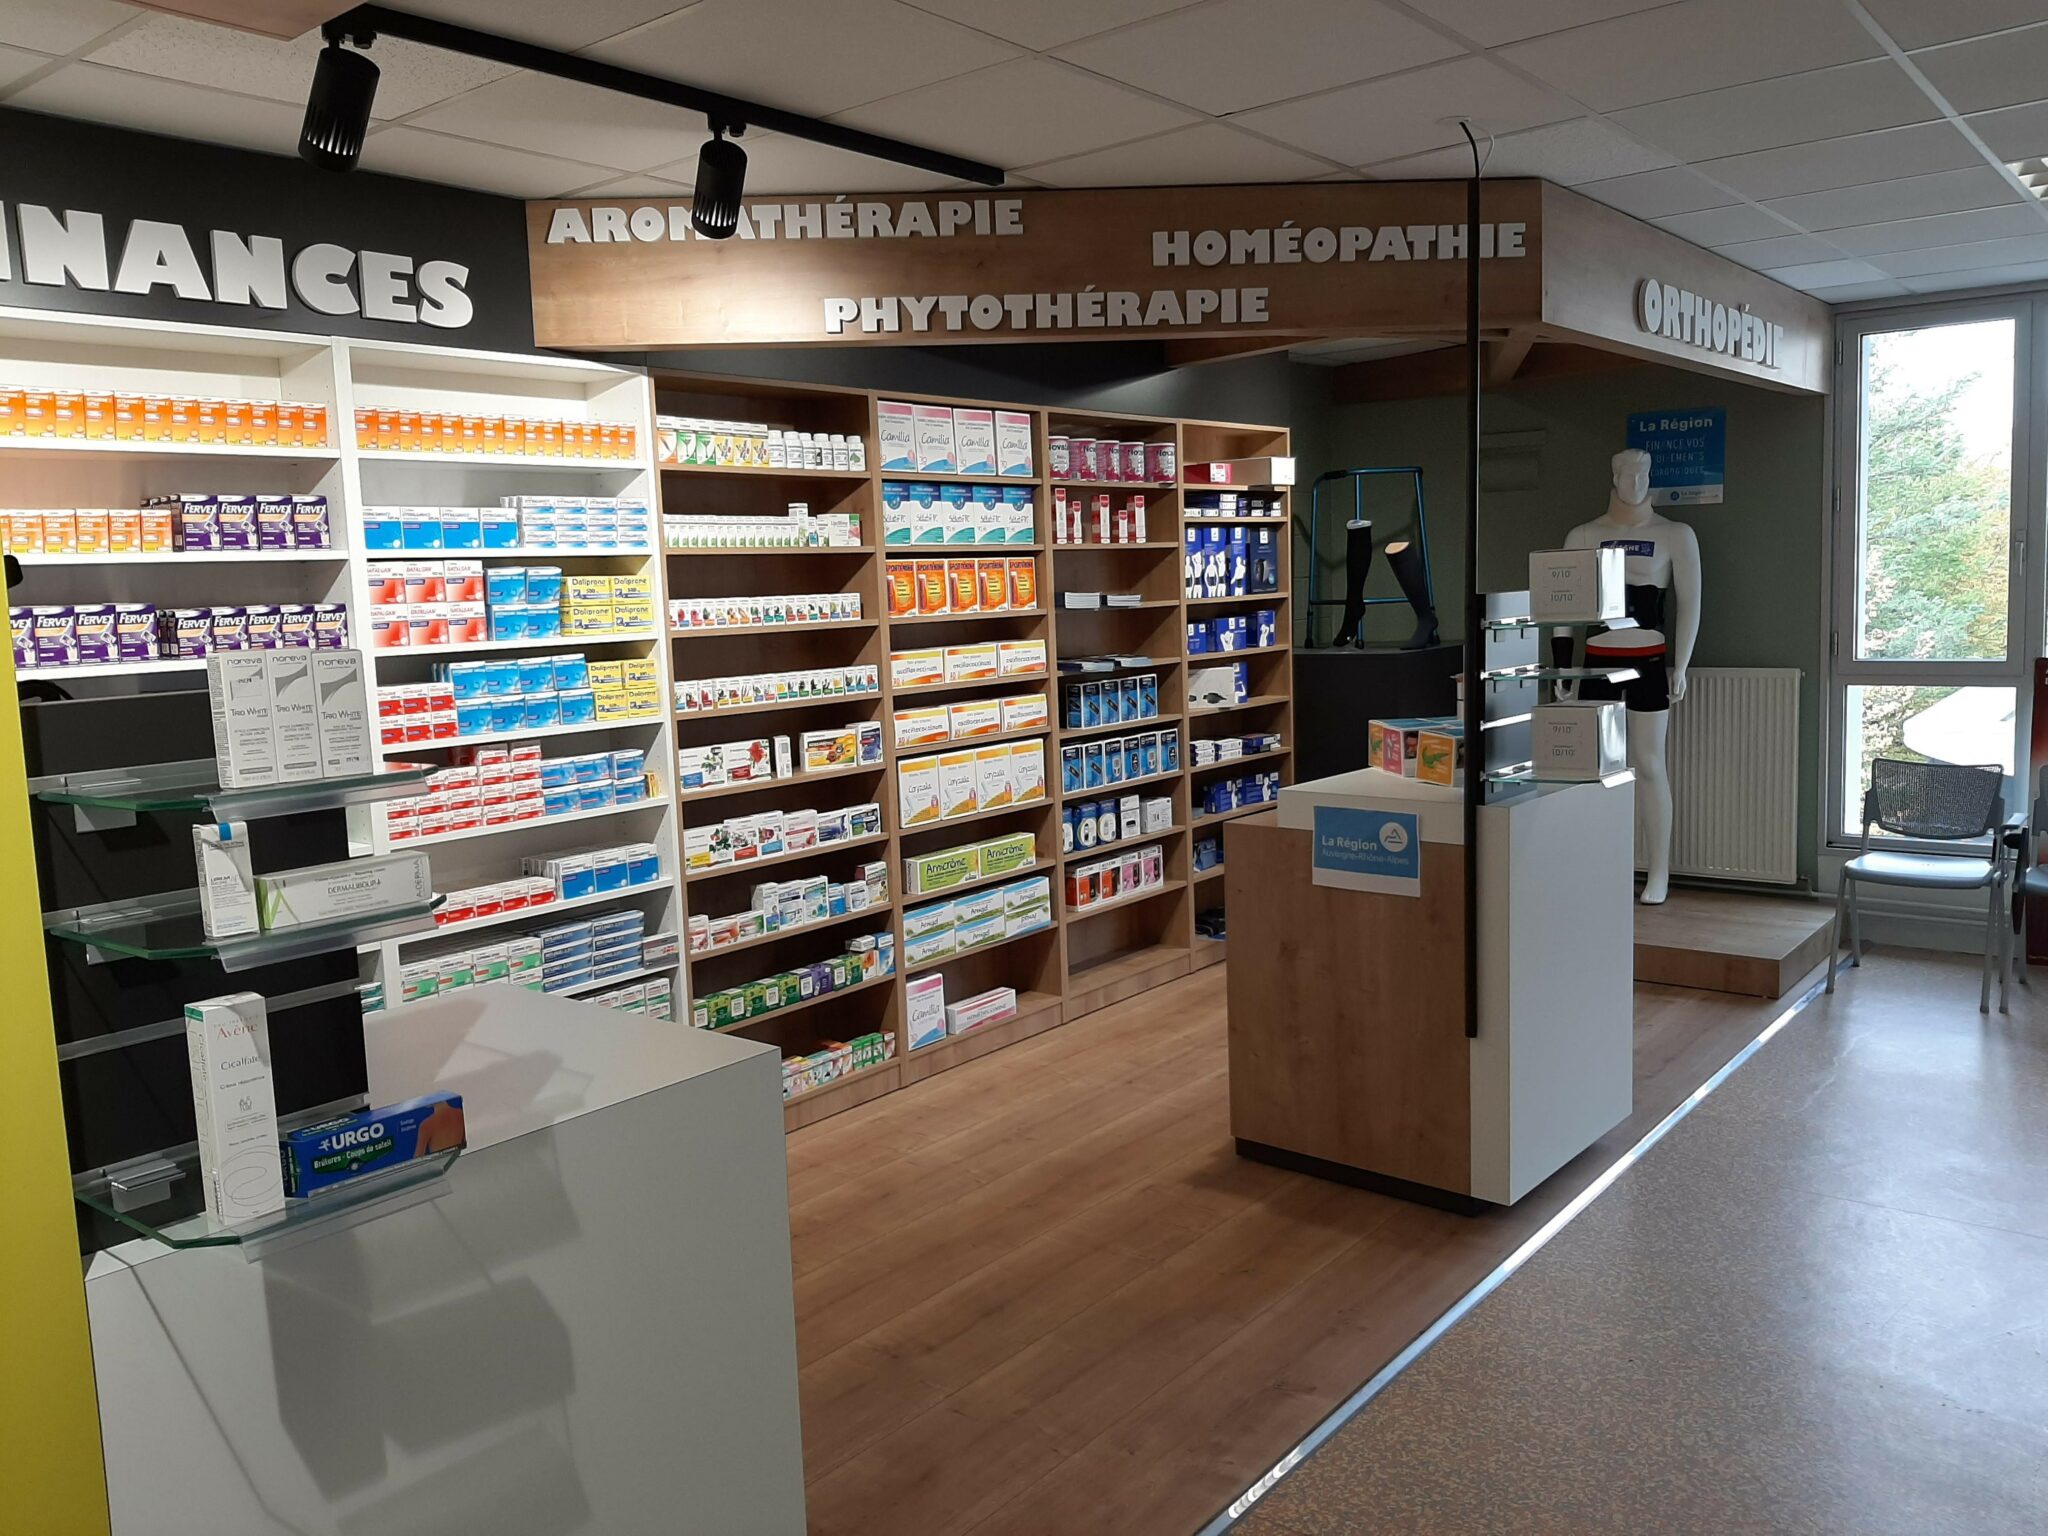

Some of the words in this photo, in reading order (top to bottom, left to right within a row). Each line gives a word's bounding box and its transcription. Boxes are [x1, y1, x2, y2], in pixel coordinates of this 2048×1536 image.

[1151, 220, 1526, 267] HOMÉOPATHIE
[0, 200, 474, 329] NANCES
[824, 284, 1269, 334] PHYTOTHÉRAPIE
[1640, 420, 1656, 432] La
[1660, 416, 1713, 432] Région
[10, 617, 32, 629] VEX
[227, 657, 262, 666] noreva
[272, 654, 307, 663] noreva
[317, 657, 356, 666] noreva
[1322, 835, 1334, 846] La
[1337, 836, 1377, 852] Région
[218, 1023, 258, 1040] Avène
[332, 1122, 384, 1150] URGO
